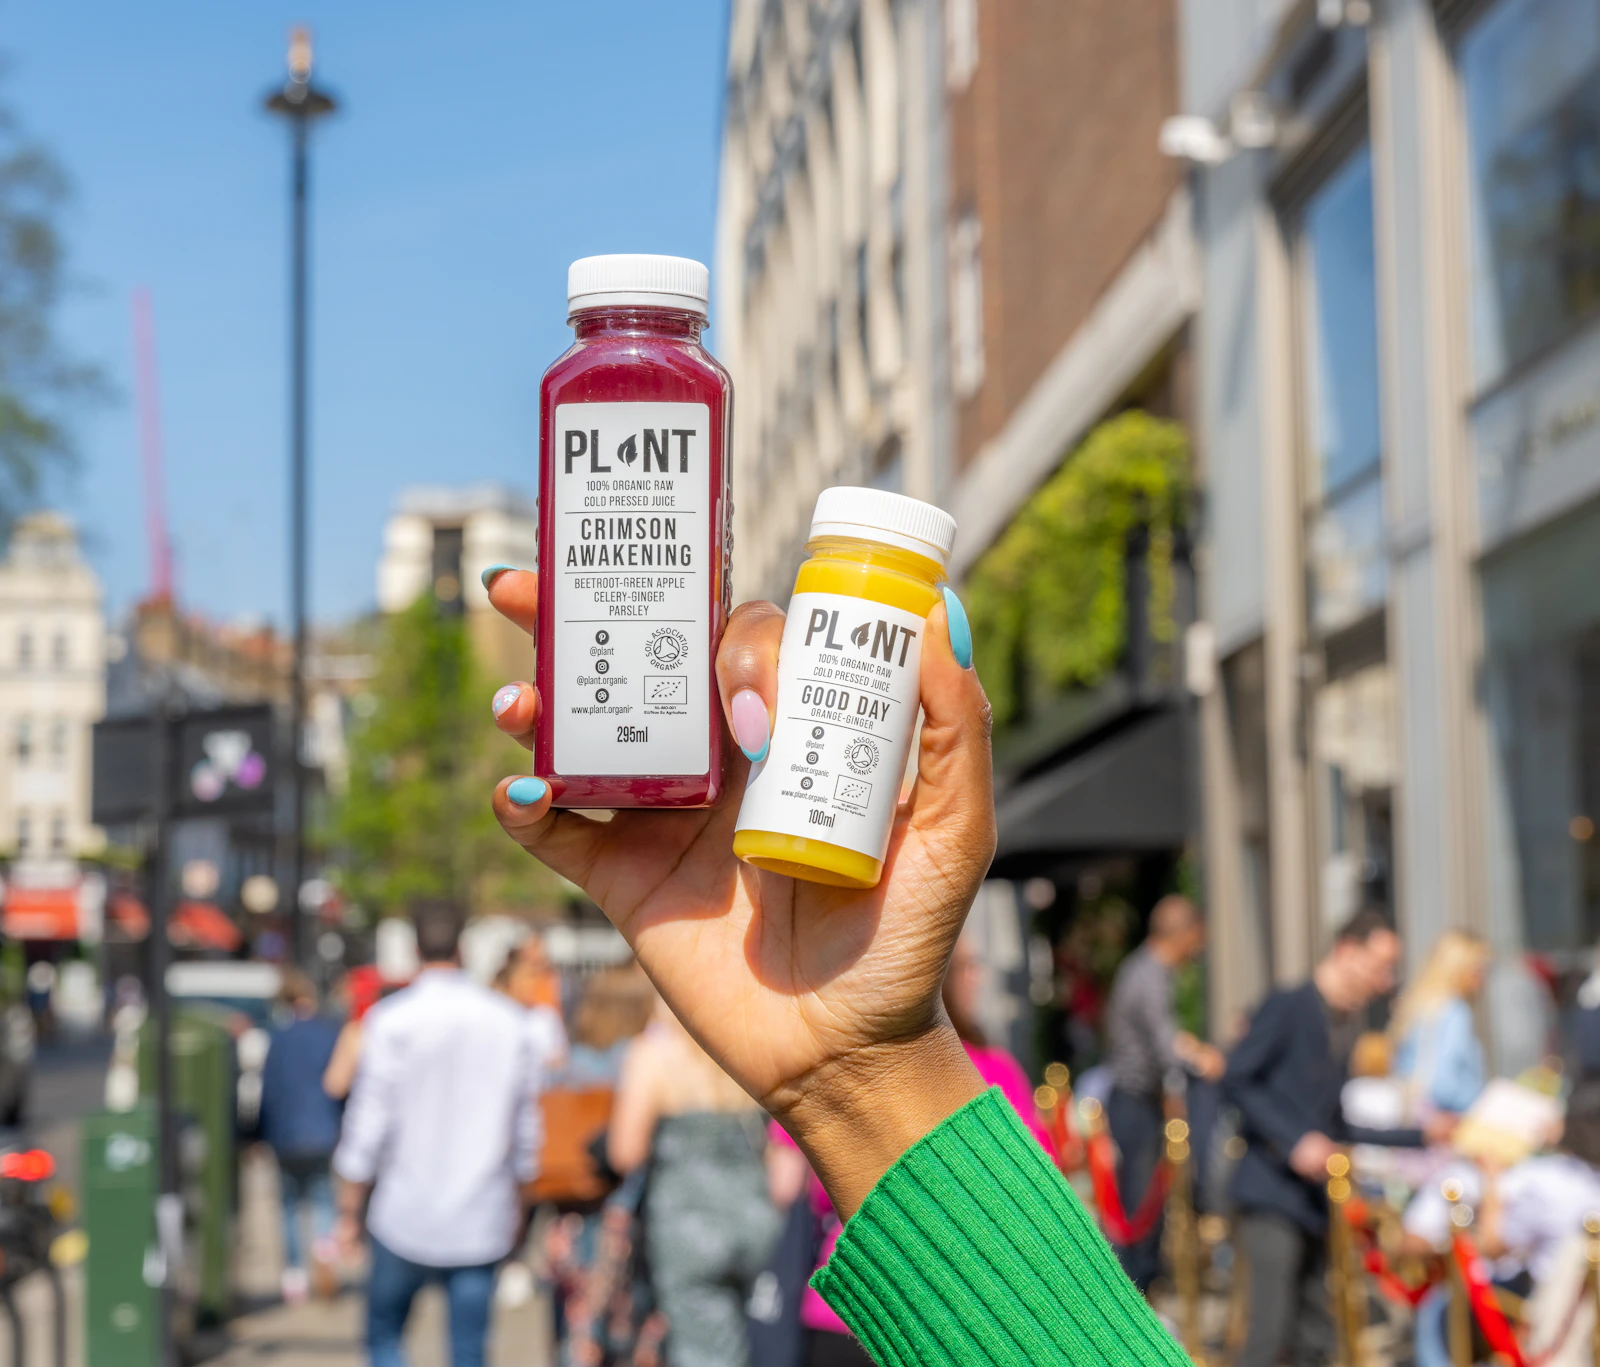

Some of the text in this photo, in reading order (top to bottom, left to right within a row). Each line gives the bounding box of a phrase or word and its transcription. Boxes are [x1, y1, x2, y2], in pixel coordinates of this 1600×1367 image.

[564, 428, 697, 475] PLNT
[586, 480, 674, 491] 100% ORGANIC RAW
[584, 495, 676, 507] COLD PRESSED JUICE
[581, 517, 676, 541] CRIMSON
[566, 544, 692, 567] AWAKENING
[574, 577, 685, 589] BEETROOT-GREEN APPLE
[593, 591, 665, 602] CELERY-GINGER
[609, 605, 649, 616] PARSLEY
[644, 627, 689, 659] SOIL ASSOCIATION
[804, 608, 917, 668] PLNT
[589, 646, 614, 656] @plant
[650, 659, 683, 671] ORGANIC
[818, 653, 893, 678] 100% ORGANIC RAW
[576, 675, 628, 686] @plant.organic
[813, 666, 891, 693] COLD PRESSED JUICE
[801, 685, 891, 722] GOOD DAY
[810, 707, 874, 730] ORANGE-GINGER
[616, 726, 649, 743] 295ml
[805, 740, 825, 750] @plant
[843, 736, 880, 768] SOIL ASSOCIATION
[790, 764, 829, 776] @plant.organic
[846, 761, 873, 775] ORGANIC
[781, 790, 829, 804] www.plant.organic
[808, 809, 836, 828] 100ml
